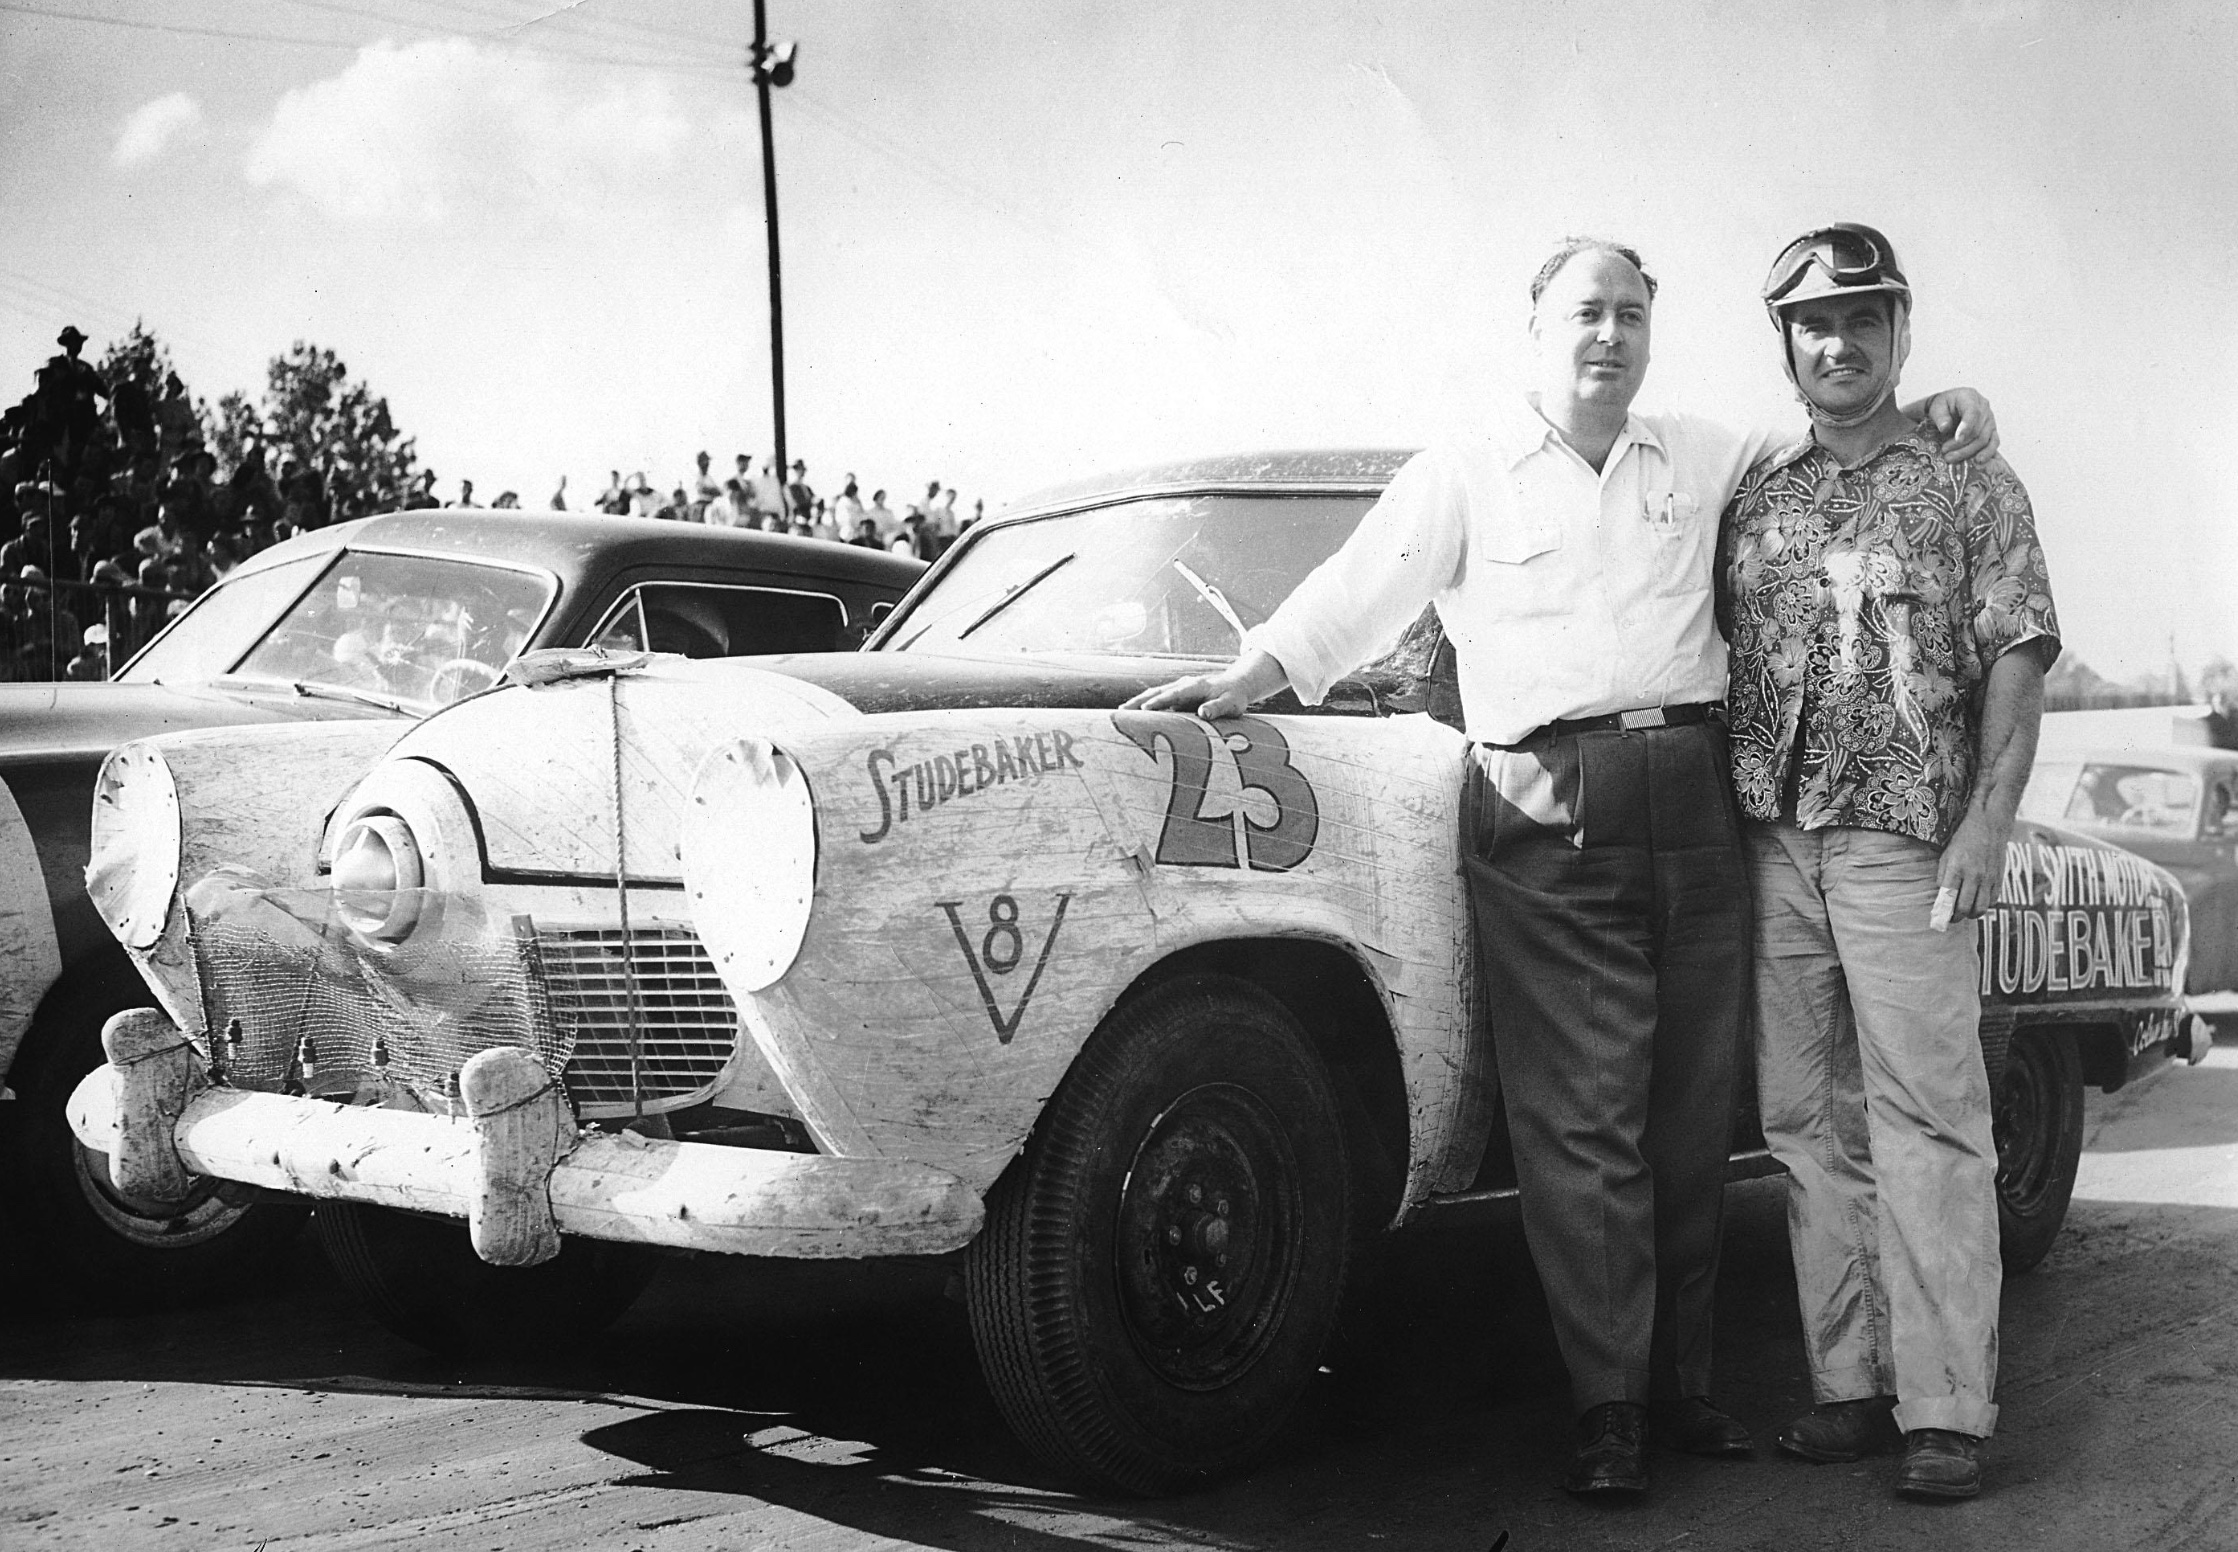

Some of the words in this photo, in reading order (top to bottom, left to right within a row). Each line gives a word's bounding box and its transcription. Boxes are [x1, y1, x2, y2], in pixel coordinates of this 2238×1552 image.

[860, 729, 1084, 844] STUDEBAKER
[1110, 711, 1319, 872] 23
[1997, 841, 2034, 906] RRY
[2038, 845, 2100, 907] SMITH
[1977, 907, 2173, 995] TUDEBAKER
